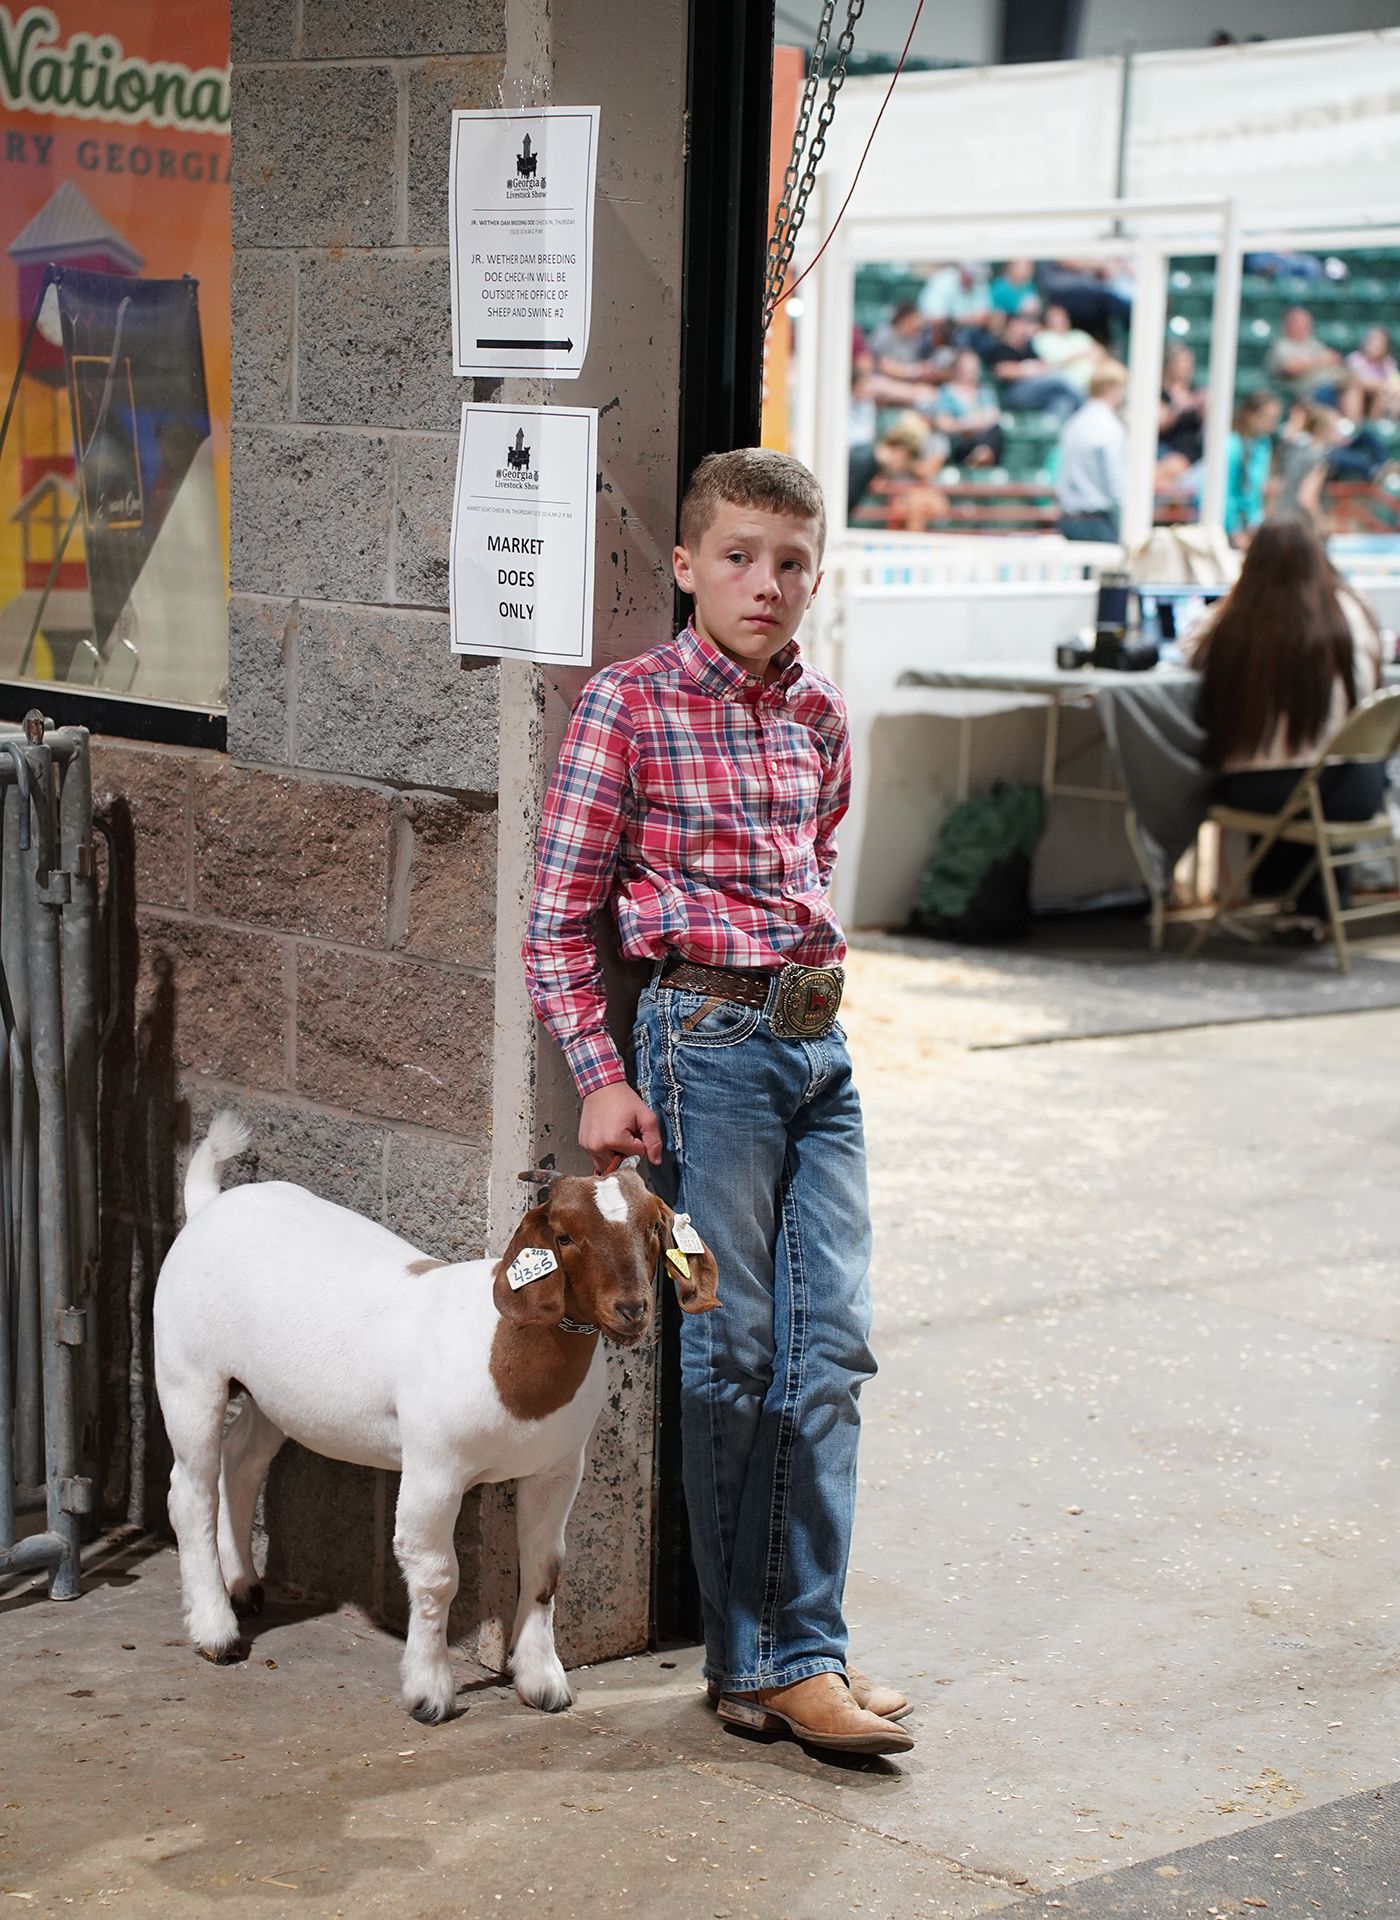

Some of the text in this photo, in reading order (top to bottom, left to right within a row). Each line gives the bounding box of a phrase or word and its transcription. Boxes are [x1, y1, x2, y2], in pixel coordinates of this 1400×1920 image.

[76, 139, 231, 184] GEORGI
[513, 178, 539, 190] Georgia
[507, 190, 530, 199] Livestock
[531, 190, 546, 199] Show
[471, 254, 576, 264] JR. WETHER DAM BREEDING
[484, 272, 566, 282] DOE CHECK-IN WILL BE
[481, 289, 569, 300] OUTSIDE THE OFFICE OF
[487, 307, 564, 318] SHEEP AND SWINE #2
[502, 468, 533, 482] Georgia
[495, 480, 523, 489] Livestock
[524, 482, 539, 490] Show
[487, 535, 544, 555] MARKET
[498, 569, 535, 588] DOES
[498, 601, 534, 620] ONLY
[514, 1257, 553, 1283] 4355
